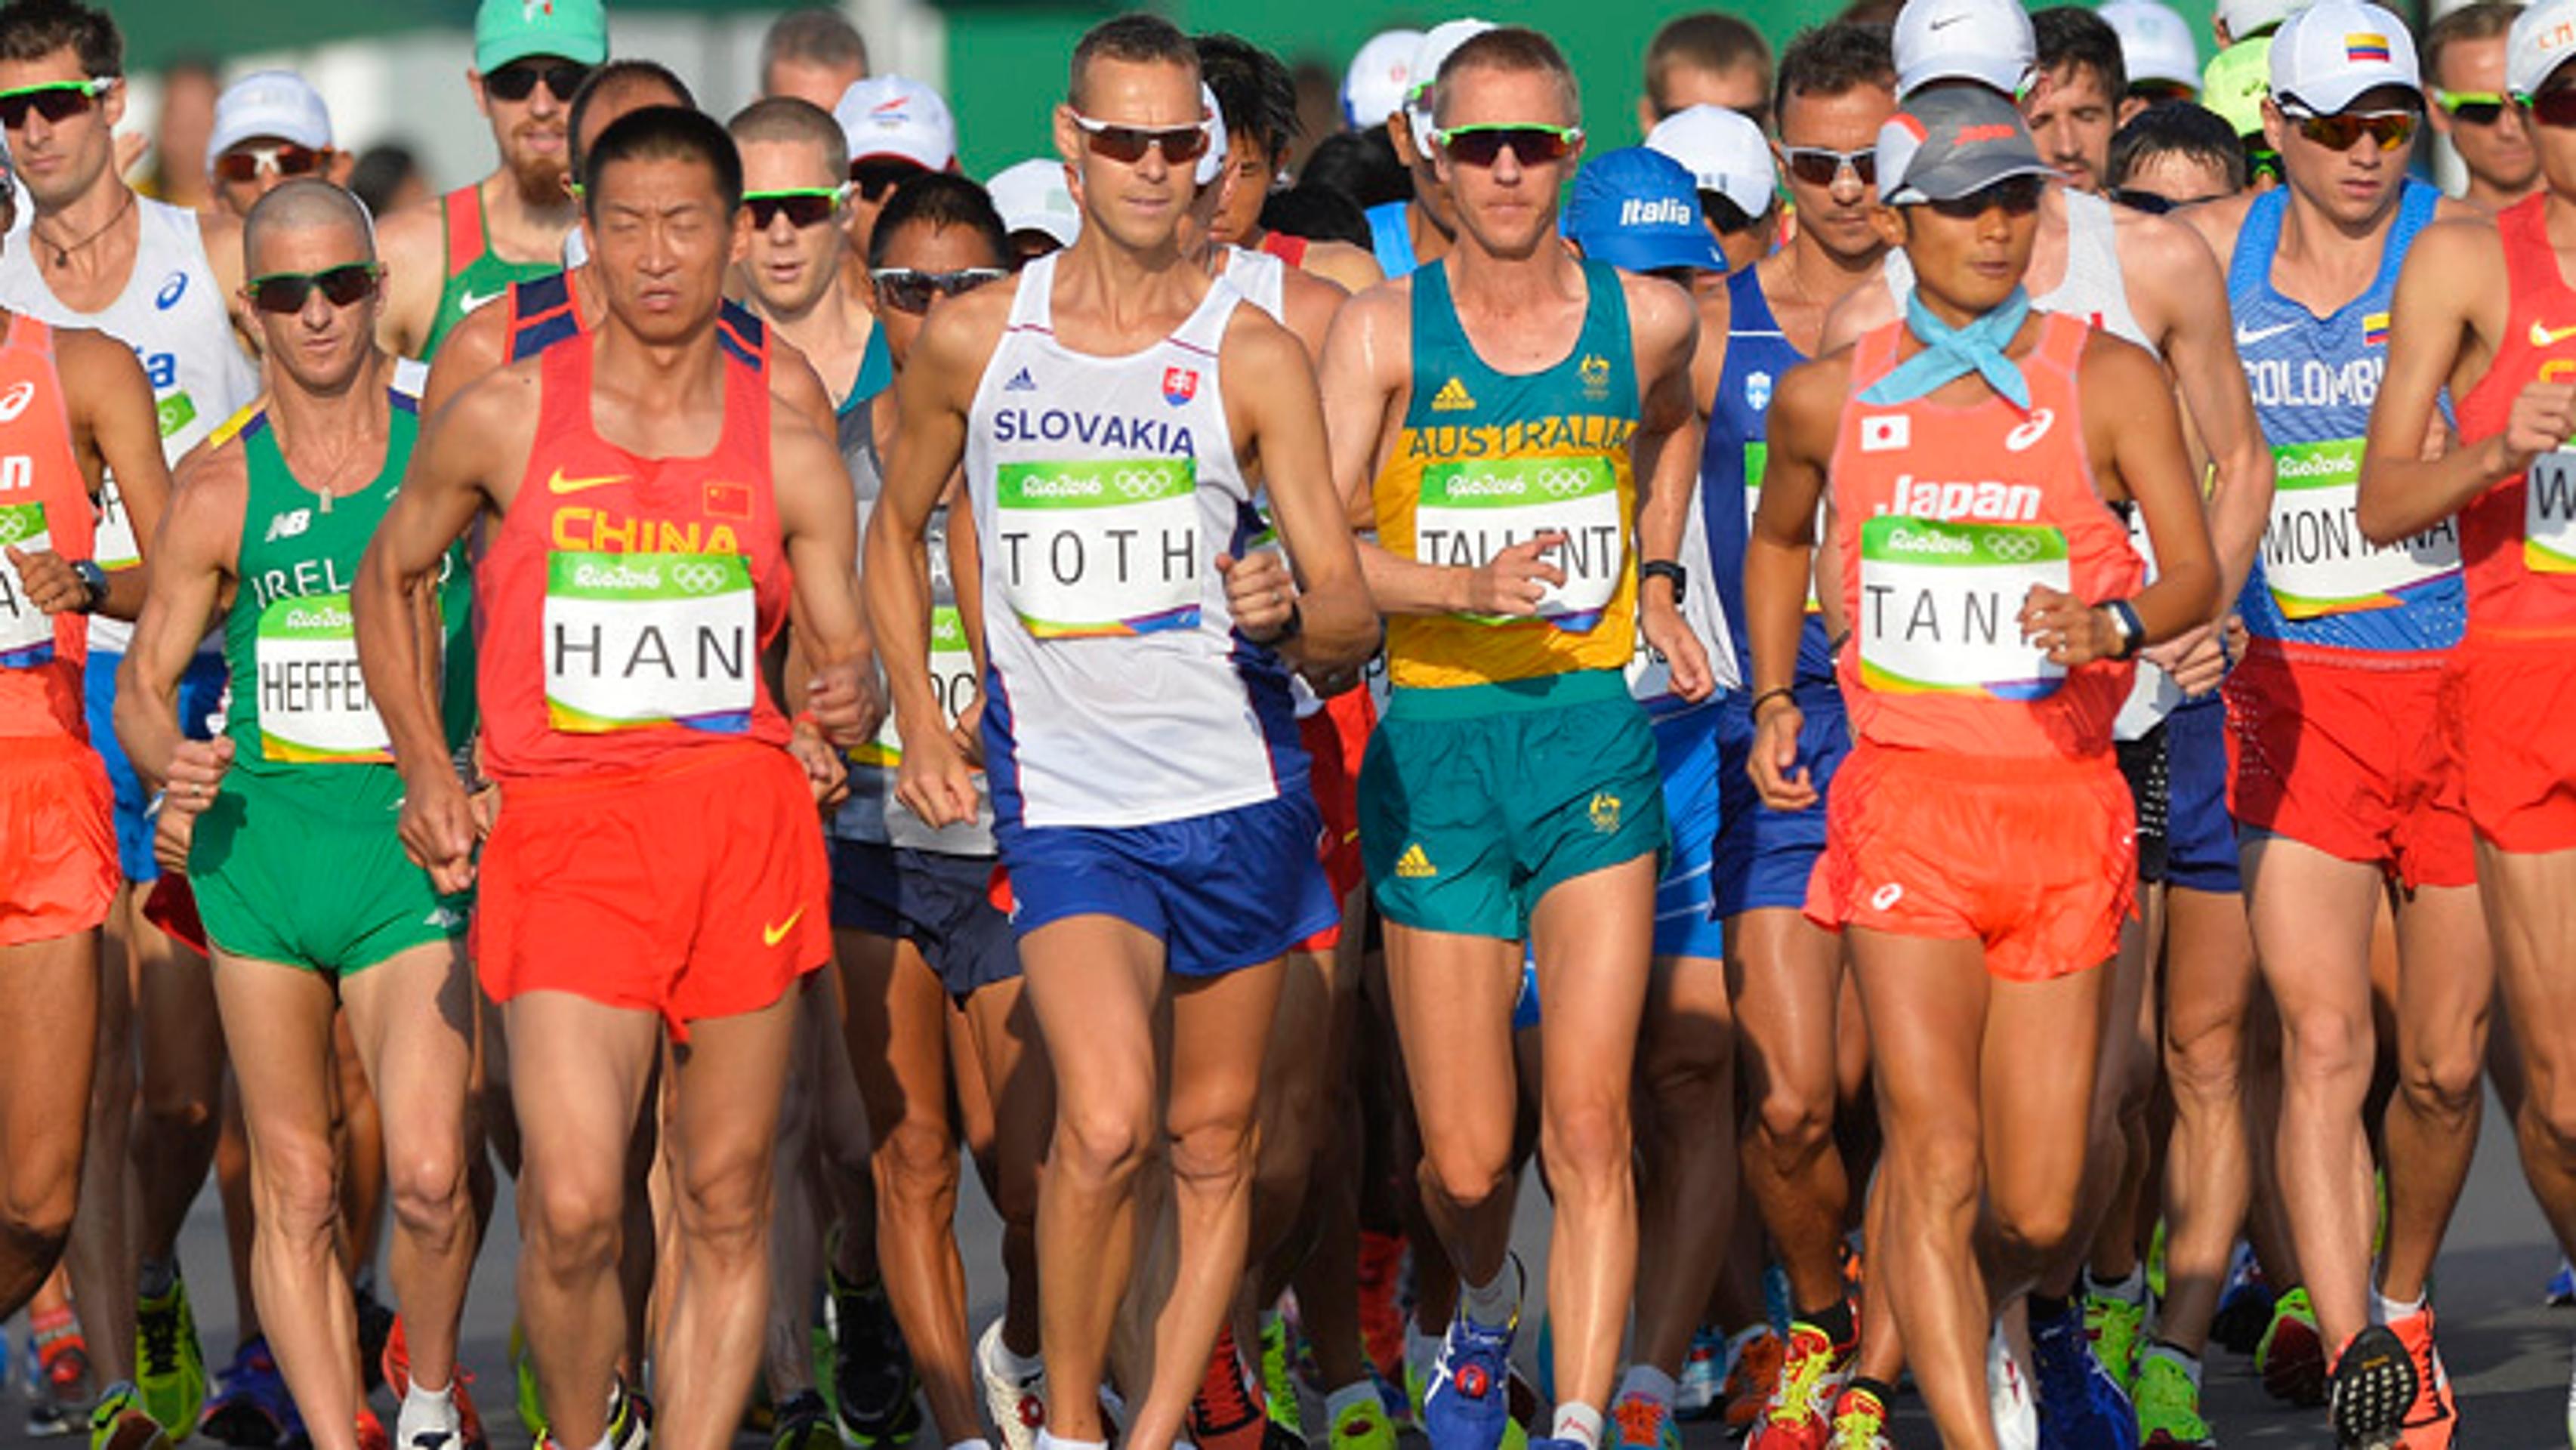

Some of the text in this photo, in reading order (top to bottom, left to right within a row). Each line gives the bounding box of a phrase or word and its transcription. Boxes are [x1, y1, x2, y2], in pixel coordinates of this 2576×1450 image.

[1620, 198, 1691, 225] Italia
[994, 409, 1195, 458] SLOVAKIA
[1409, 416, 1629, 458] AUSTRALIA
[1023, 474, 1102, 497] Rio2016
[1445, 473, 1526, 497] Rio2016
[2276, 451, 2355, 477] Rio2016
[1874, 475, 2041, 522] Japan
[553, 507, 738, 556] CHINA
[1889, 529, 1973, 553] Rio2016
[574, 563, 661, 588] Rio2016
[1001, 529, 1193, 585] TOTH
[1865, 585, 2028, 646] TAN
[555, 624, 743, 678] HAN
[262, 661, 369, 711] HEFFE
